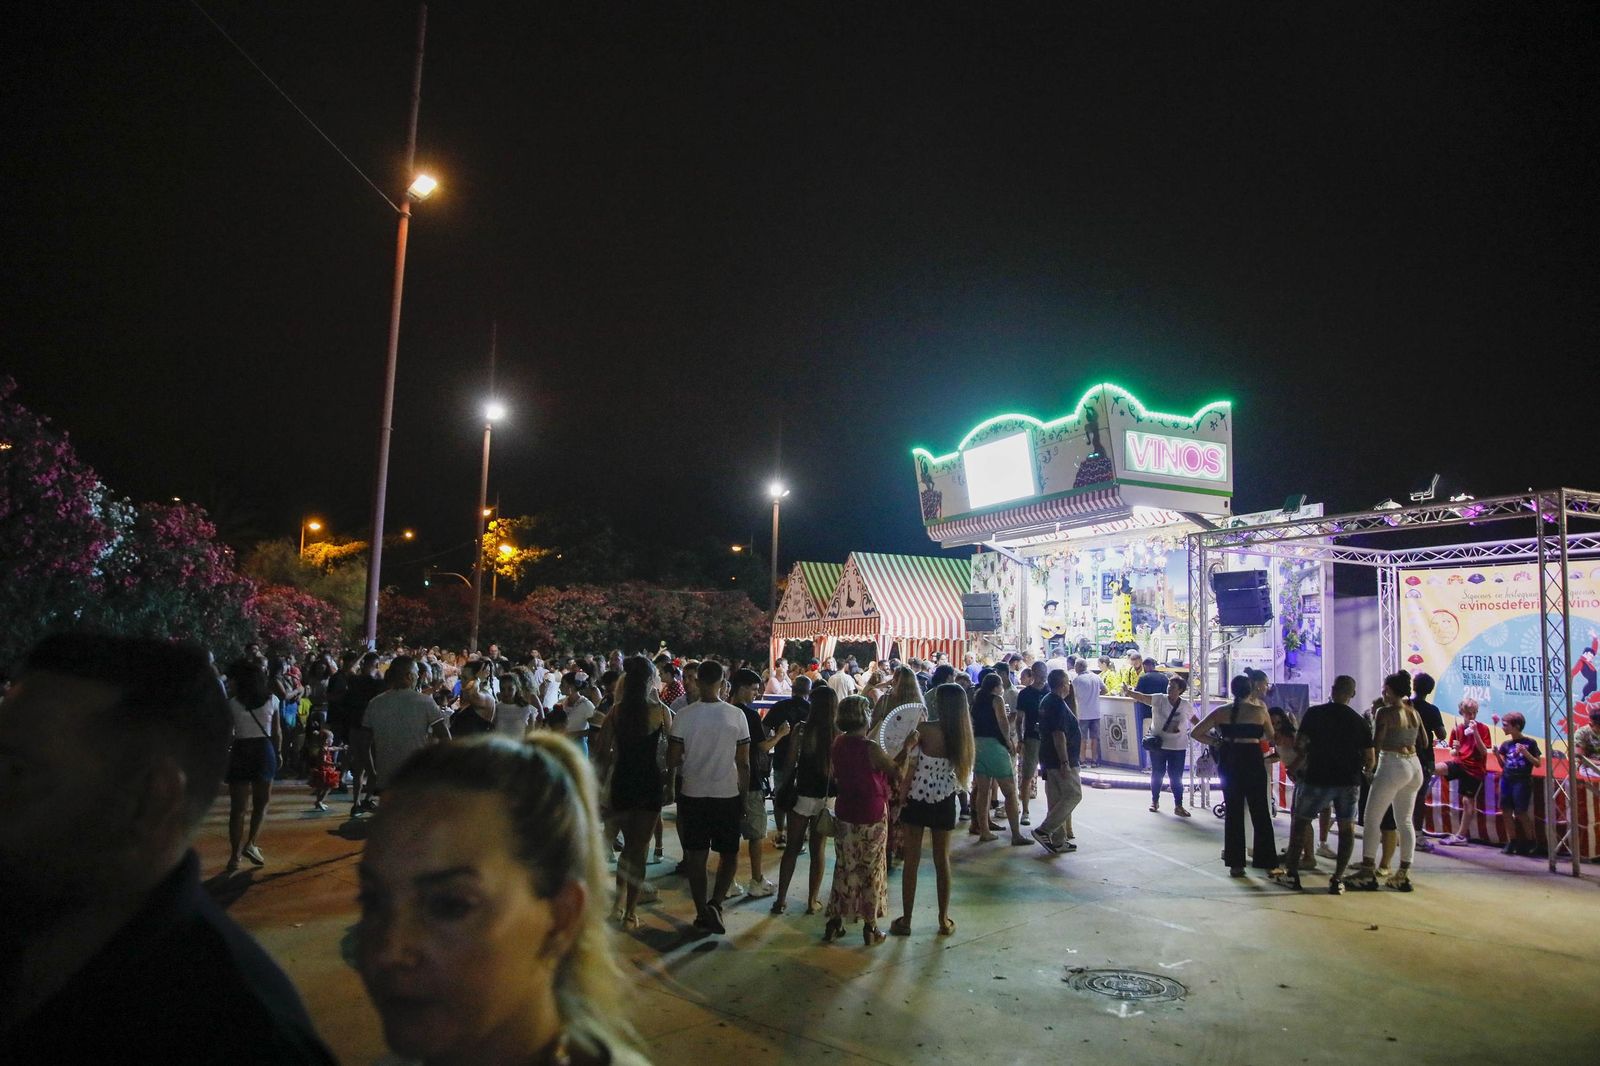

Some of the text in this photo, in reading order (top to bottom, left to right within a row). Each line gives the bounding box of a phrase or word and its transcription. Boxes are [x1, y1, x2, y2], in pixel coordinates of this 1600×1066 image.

[1127, 434, 1224, 478] VINOS
[1458, 598, 1547, 611] @vinosdeferi
[1497, 655, 1507, 672] Y
[1463, 686, 1491, 702] 2024
